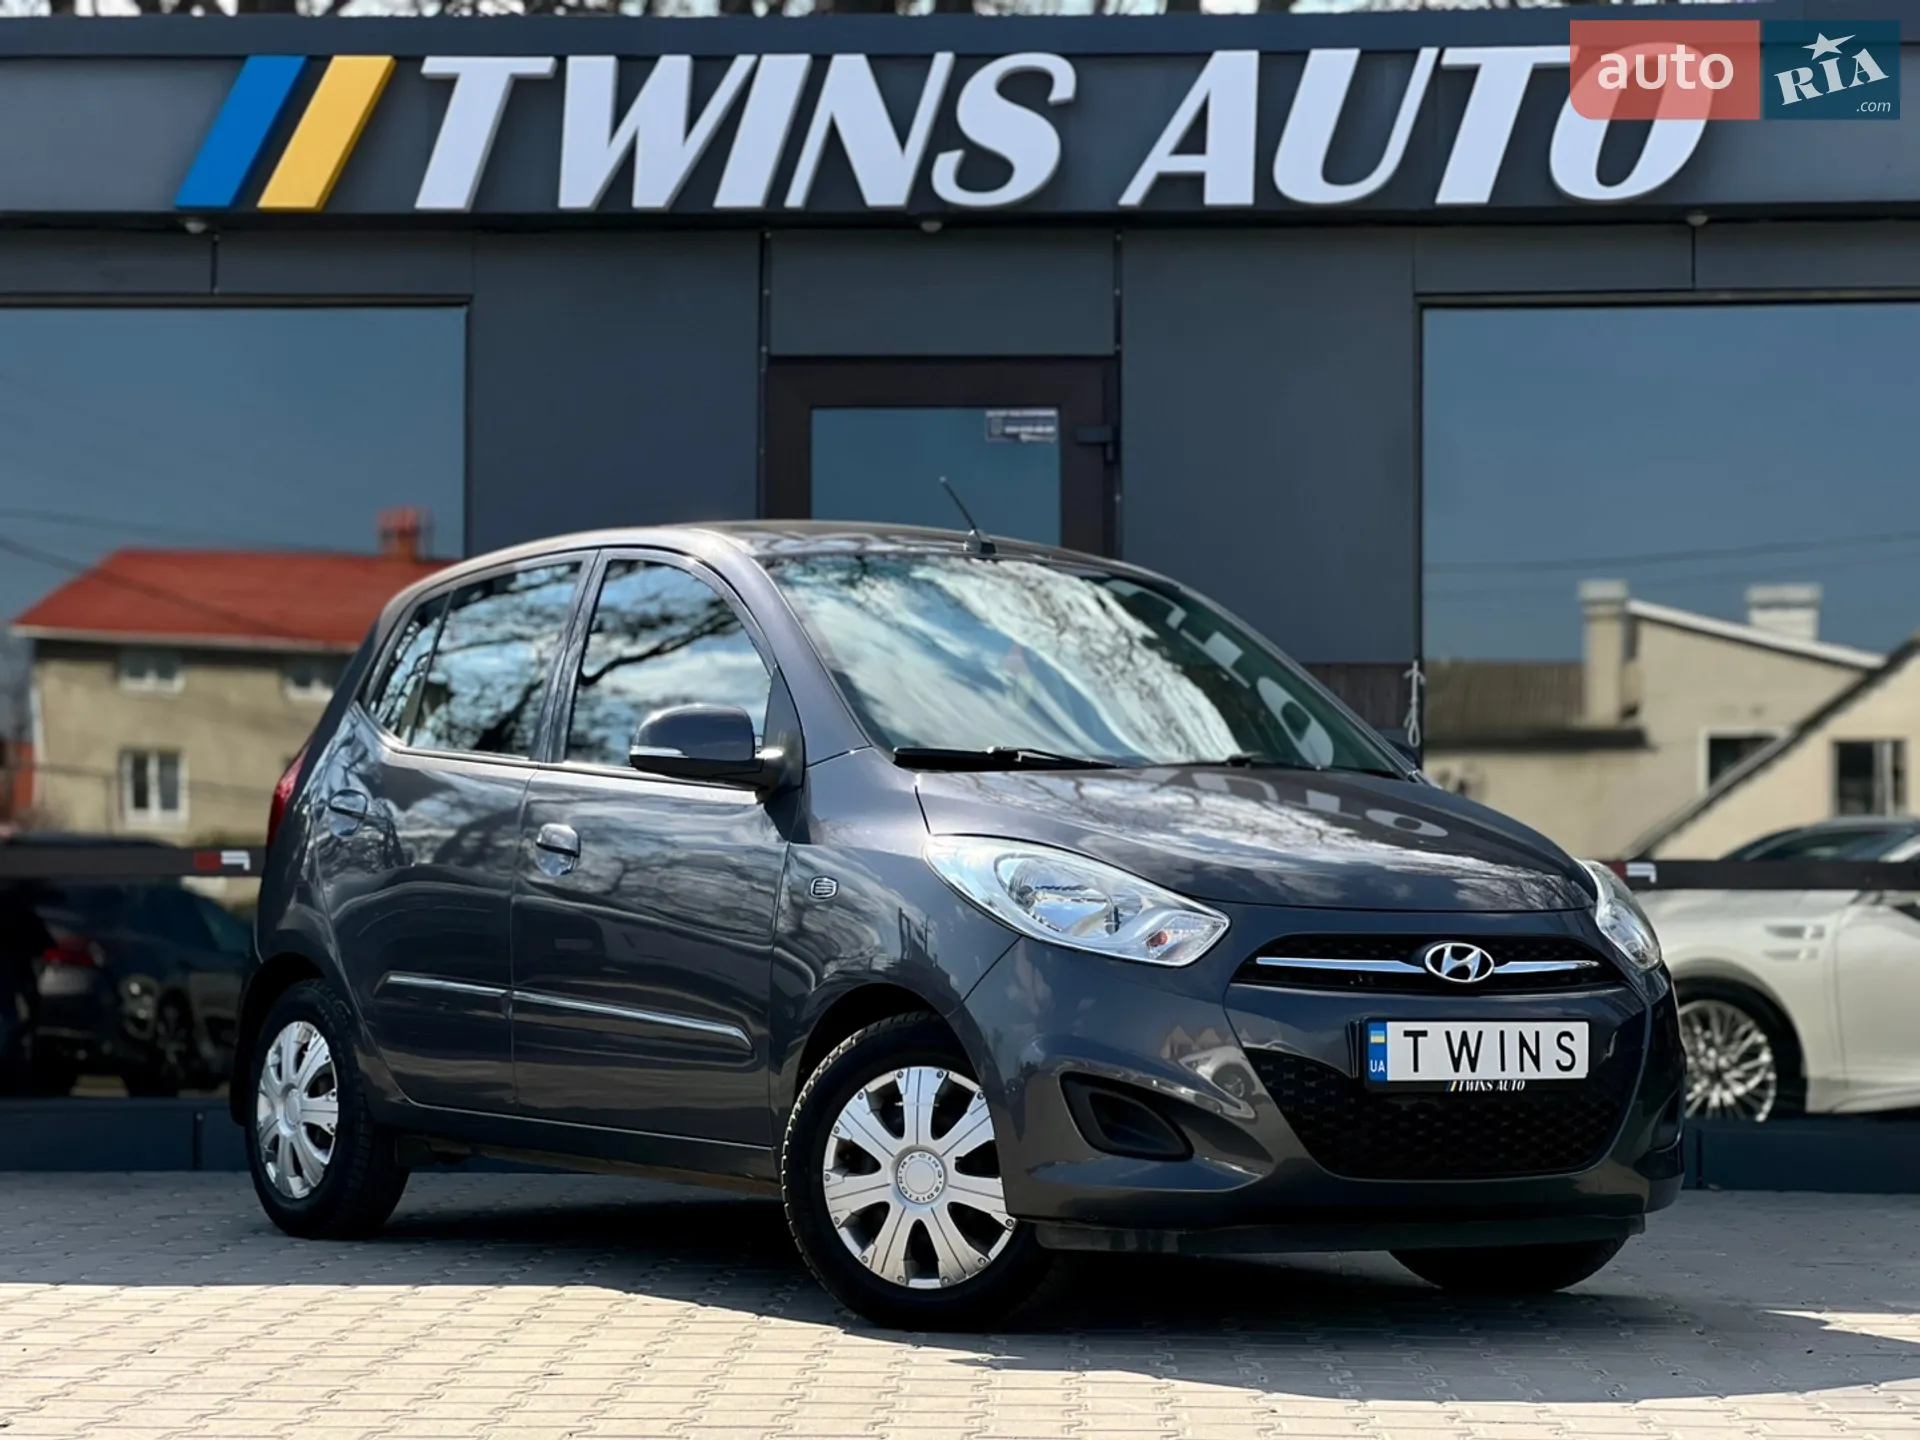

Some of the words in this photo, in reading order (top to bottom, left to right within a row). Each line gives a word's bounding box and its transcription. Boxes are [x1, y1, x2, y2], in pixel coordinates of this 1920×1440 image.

[415, 51, 1077, 210] TWINS
[1118, 43, 1714, 206] AUTO
[1370, 1059, 1386, 1073] UA
[1403, 1029, 1576, 1074] TWINS
[1458, 1080, 1493, 1092] TWINS
[1495, 1080, 1526, 1092] AUTO
